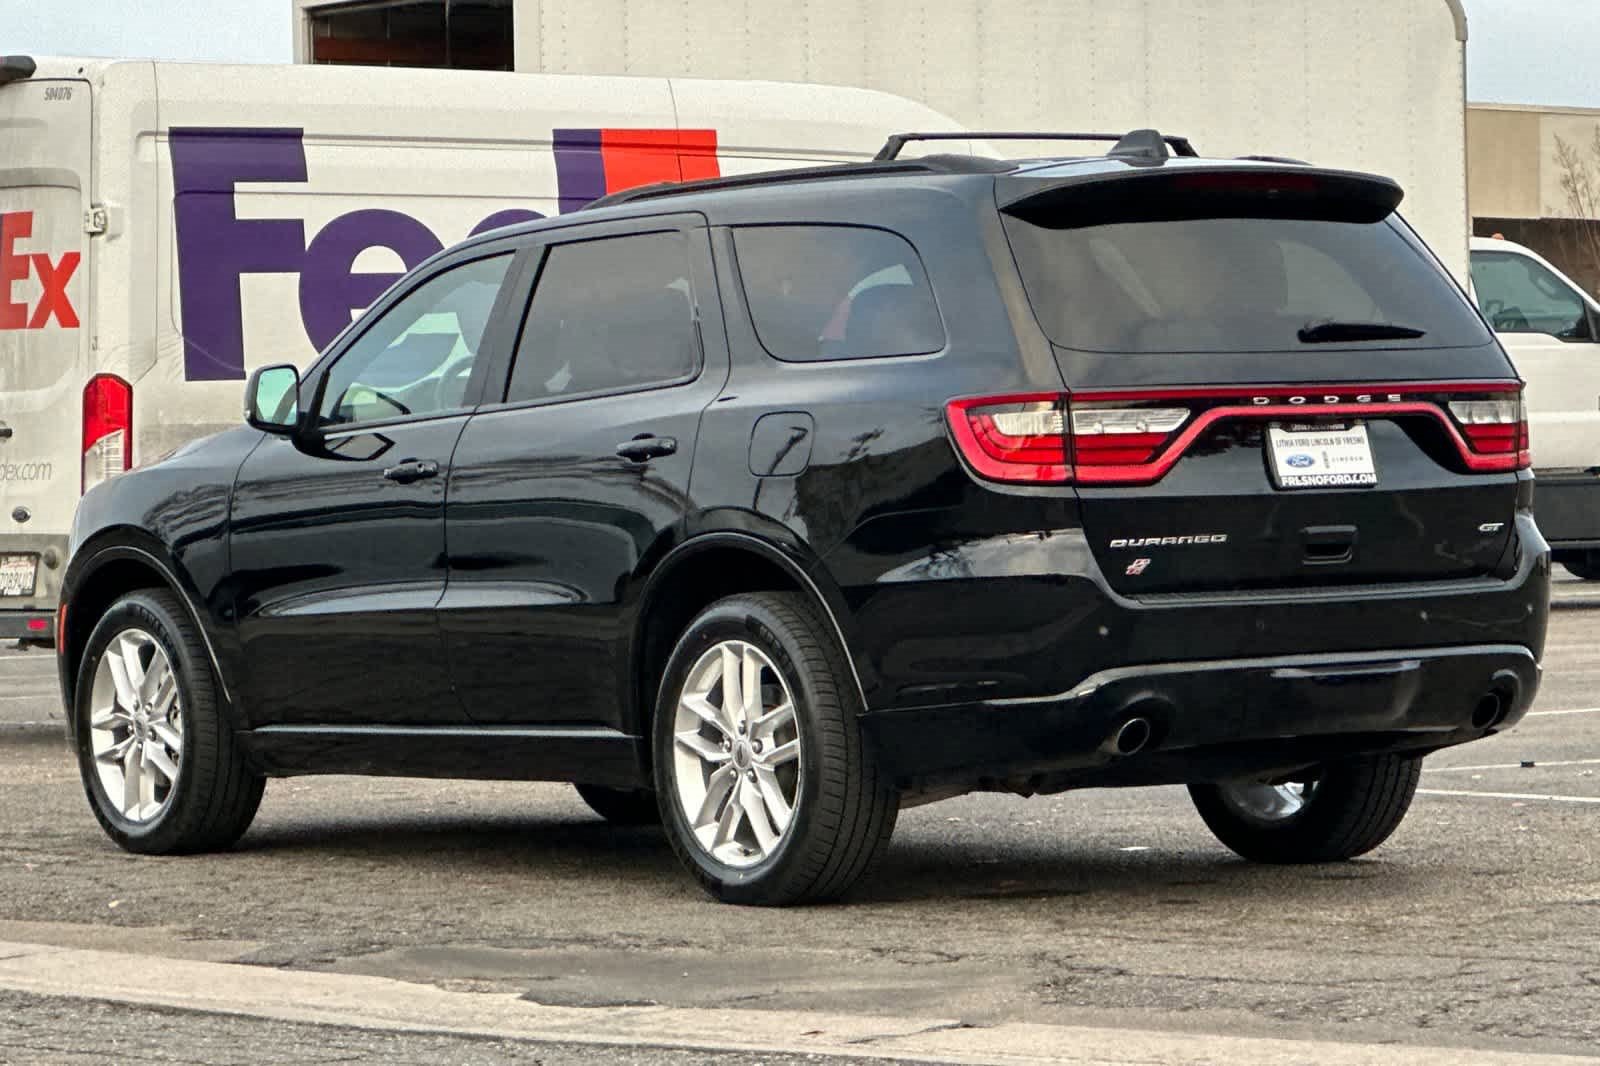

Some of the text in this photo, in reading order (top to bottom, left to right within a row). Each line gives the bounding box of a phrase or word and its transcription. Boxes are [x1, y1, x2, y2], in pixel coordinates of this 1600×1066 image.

[0, 211, 80, 330] Ex
[1252, 394, 1401, 405] DODGE
[1478, 522, 1504, 532] GT
[1110, 534, 1228, 548] DURANGO
